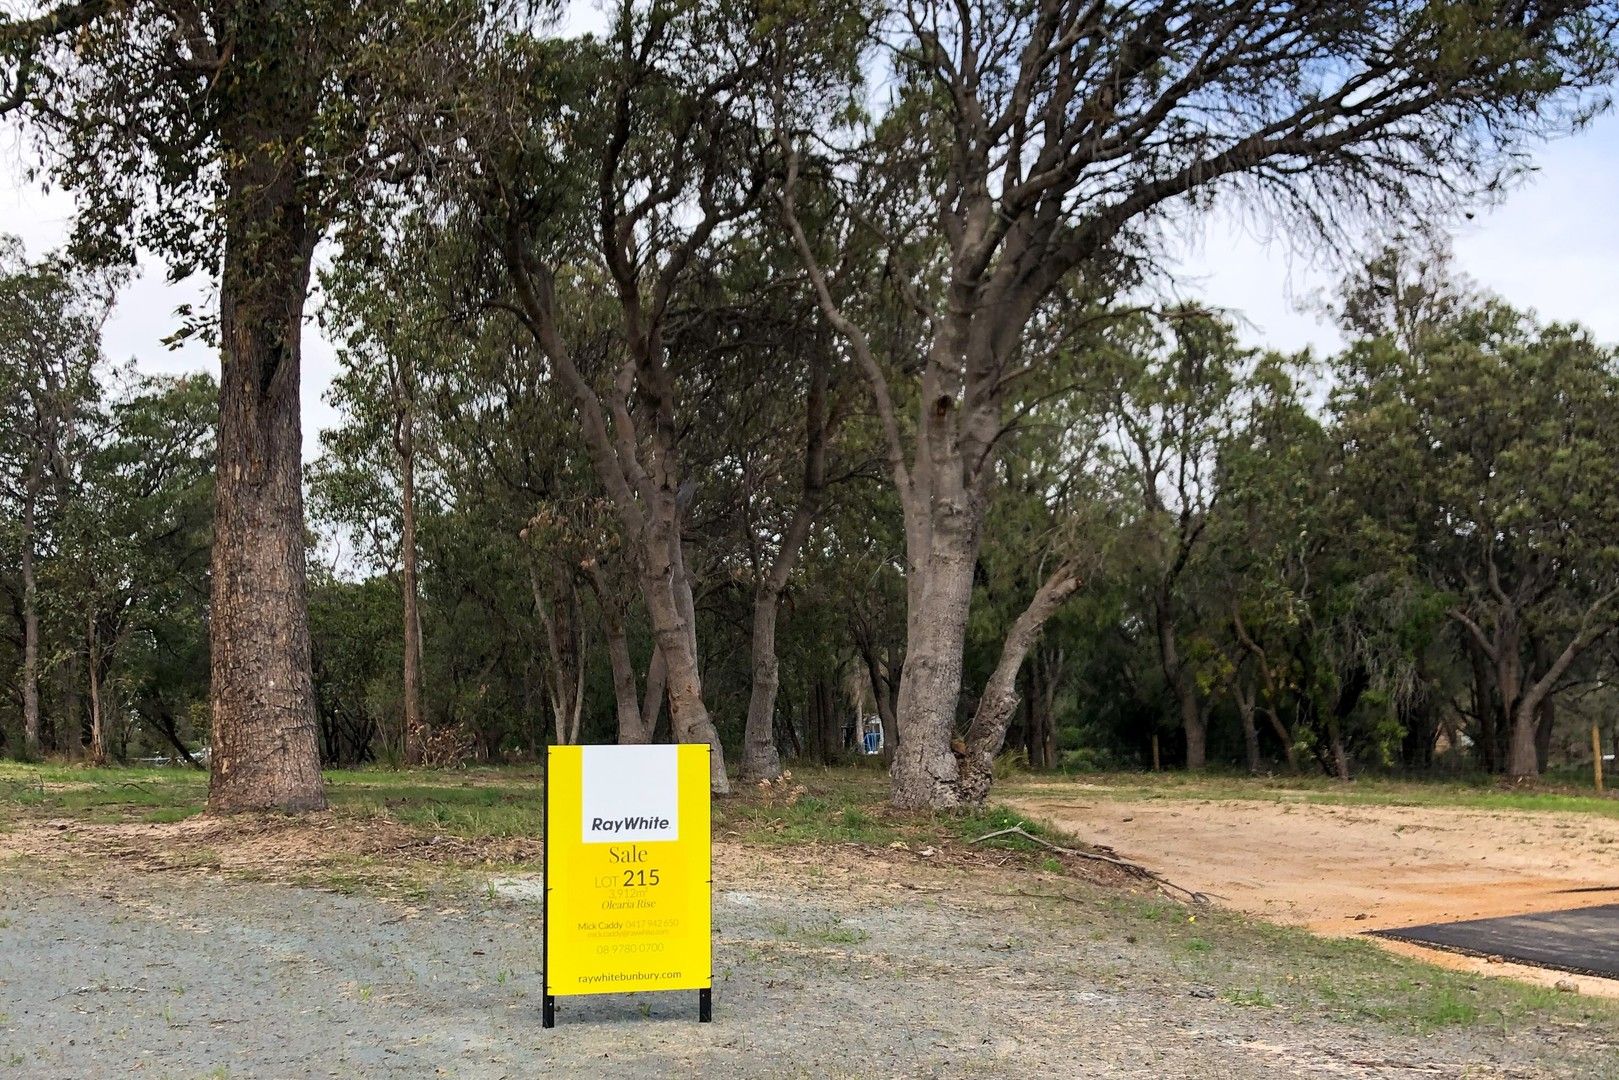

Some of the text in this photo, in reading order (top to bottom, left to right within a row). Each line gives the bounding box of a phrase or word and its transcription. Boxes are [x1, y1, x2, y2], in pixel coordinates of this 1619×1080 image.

[609, 844, 648, 864] Sale
[594, 869, 660, 889] LOT 215
[637, 899, 656, 909] Rise
[577, 921, 597, 931] Mick
[598, 920, 623, 932] Caddy
[578, 971, 682, 984] raywhitebunbury.com
